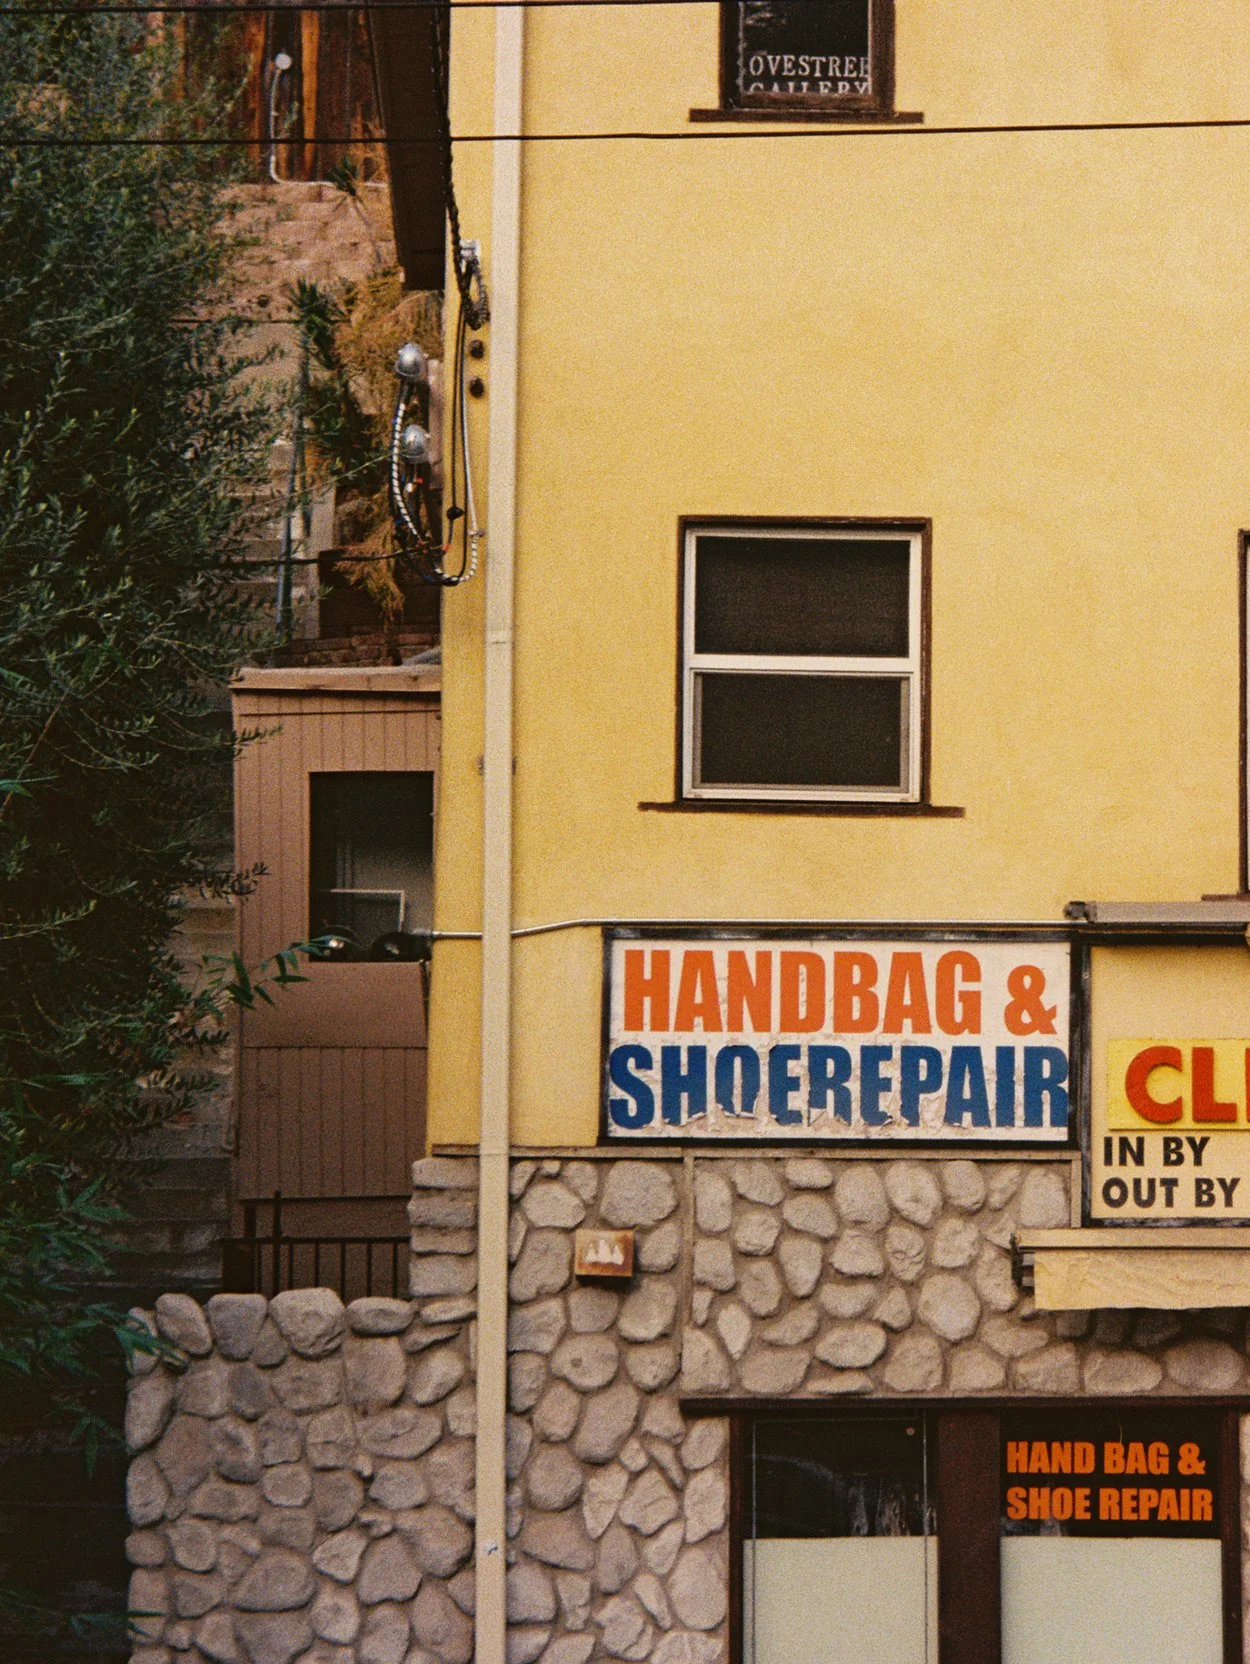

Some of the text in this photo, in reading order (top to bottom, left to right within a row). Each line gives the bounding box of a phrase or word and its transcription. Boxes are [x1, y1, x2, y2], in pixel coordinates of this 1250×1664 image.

[623, 949, 1057, 1036] HANDBAG &
[1103, 1137, 1146, 1167] IN
[1162, 1137, 1211, 1167] BY
[1102, 1177, 1179, 1208] OUT
[1195, 1177, 1240, 1208] BY
[1007, 1441, 1207, 1476] HAND BAG &
[1007, 1487, 1213, 1521] SHOE REPAIR
